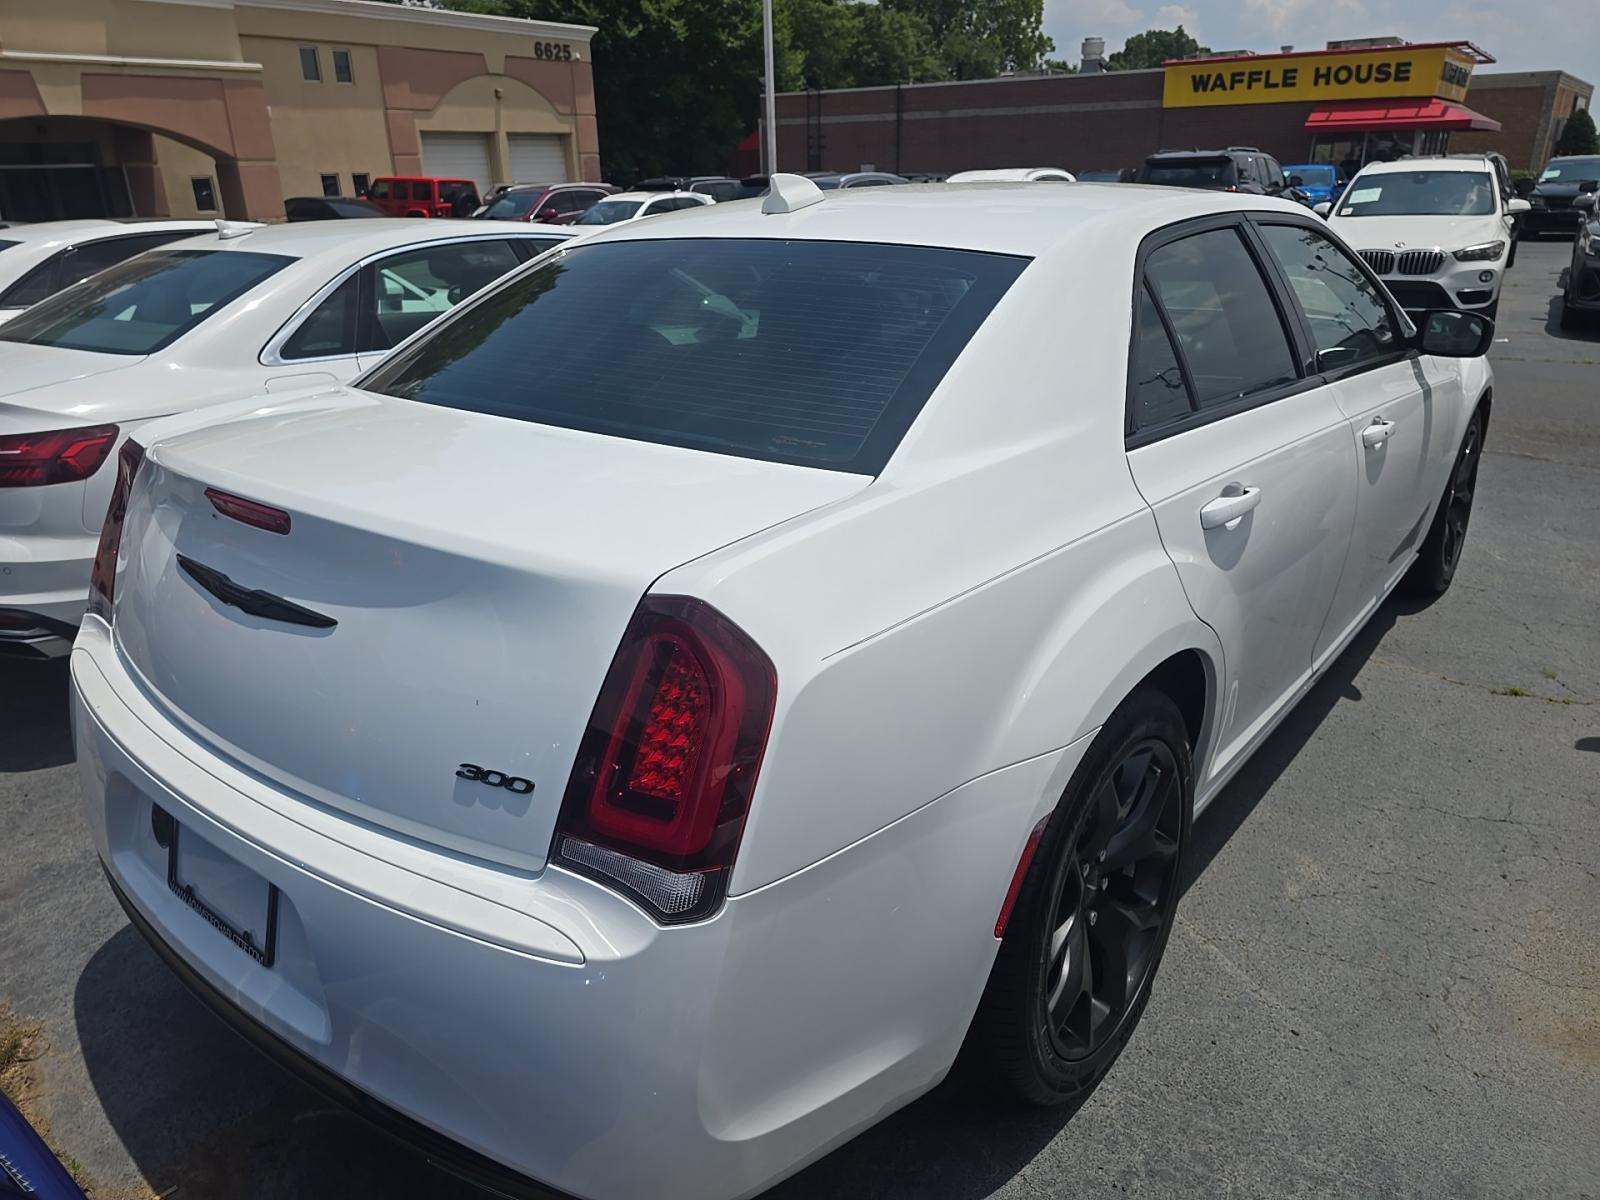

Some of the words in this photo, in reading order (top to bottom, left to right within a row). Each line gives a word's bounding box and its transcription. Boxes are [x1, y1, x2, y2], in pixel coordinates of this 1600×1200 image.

[535, 40, 572, 61] 6625
[1191, 69, 1298, 93] WAFFLE
[1313, 61, 1412, 87] HOUSE
[455, 763, 535, 794] 300
